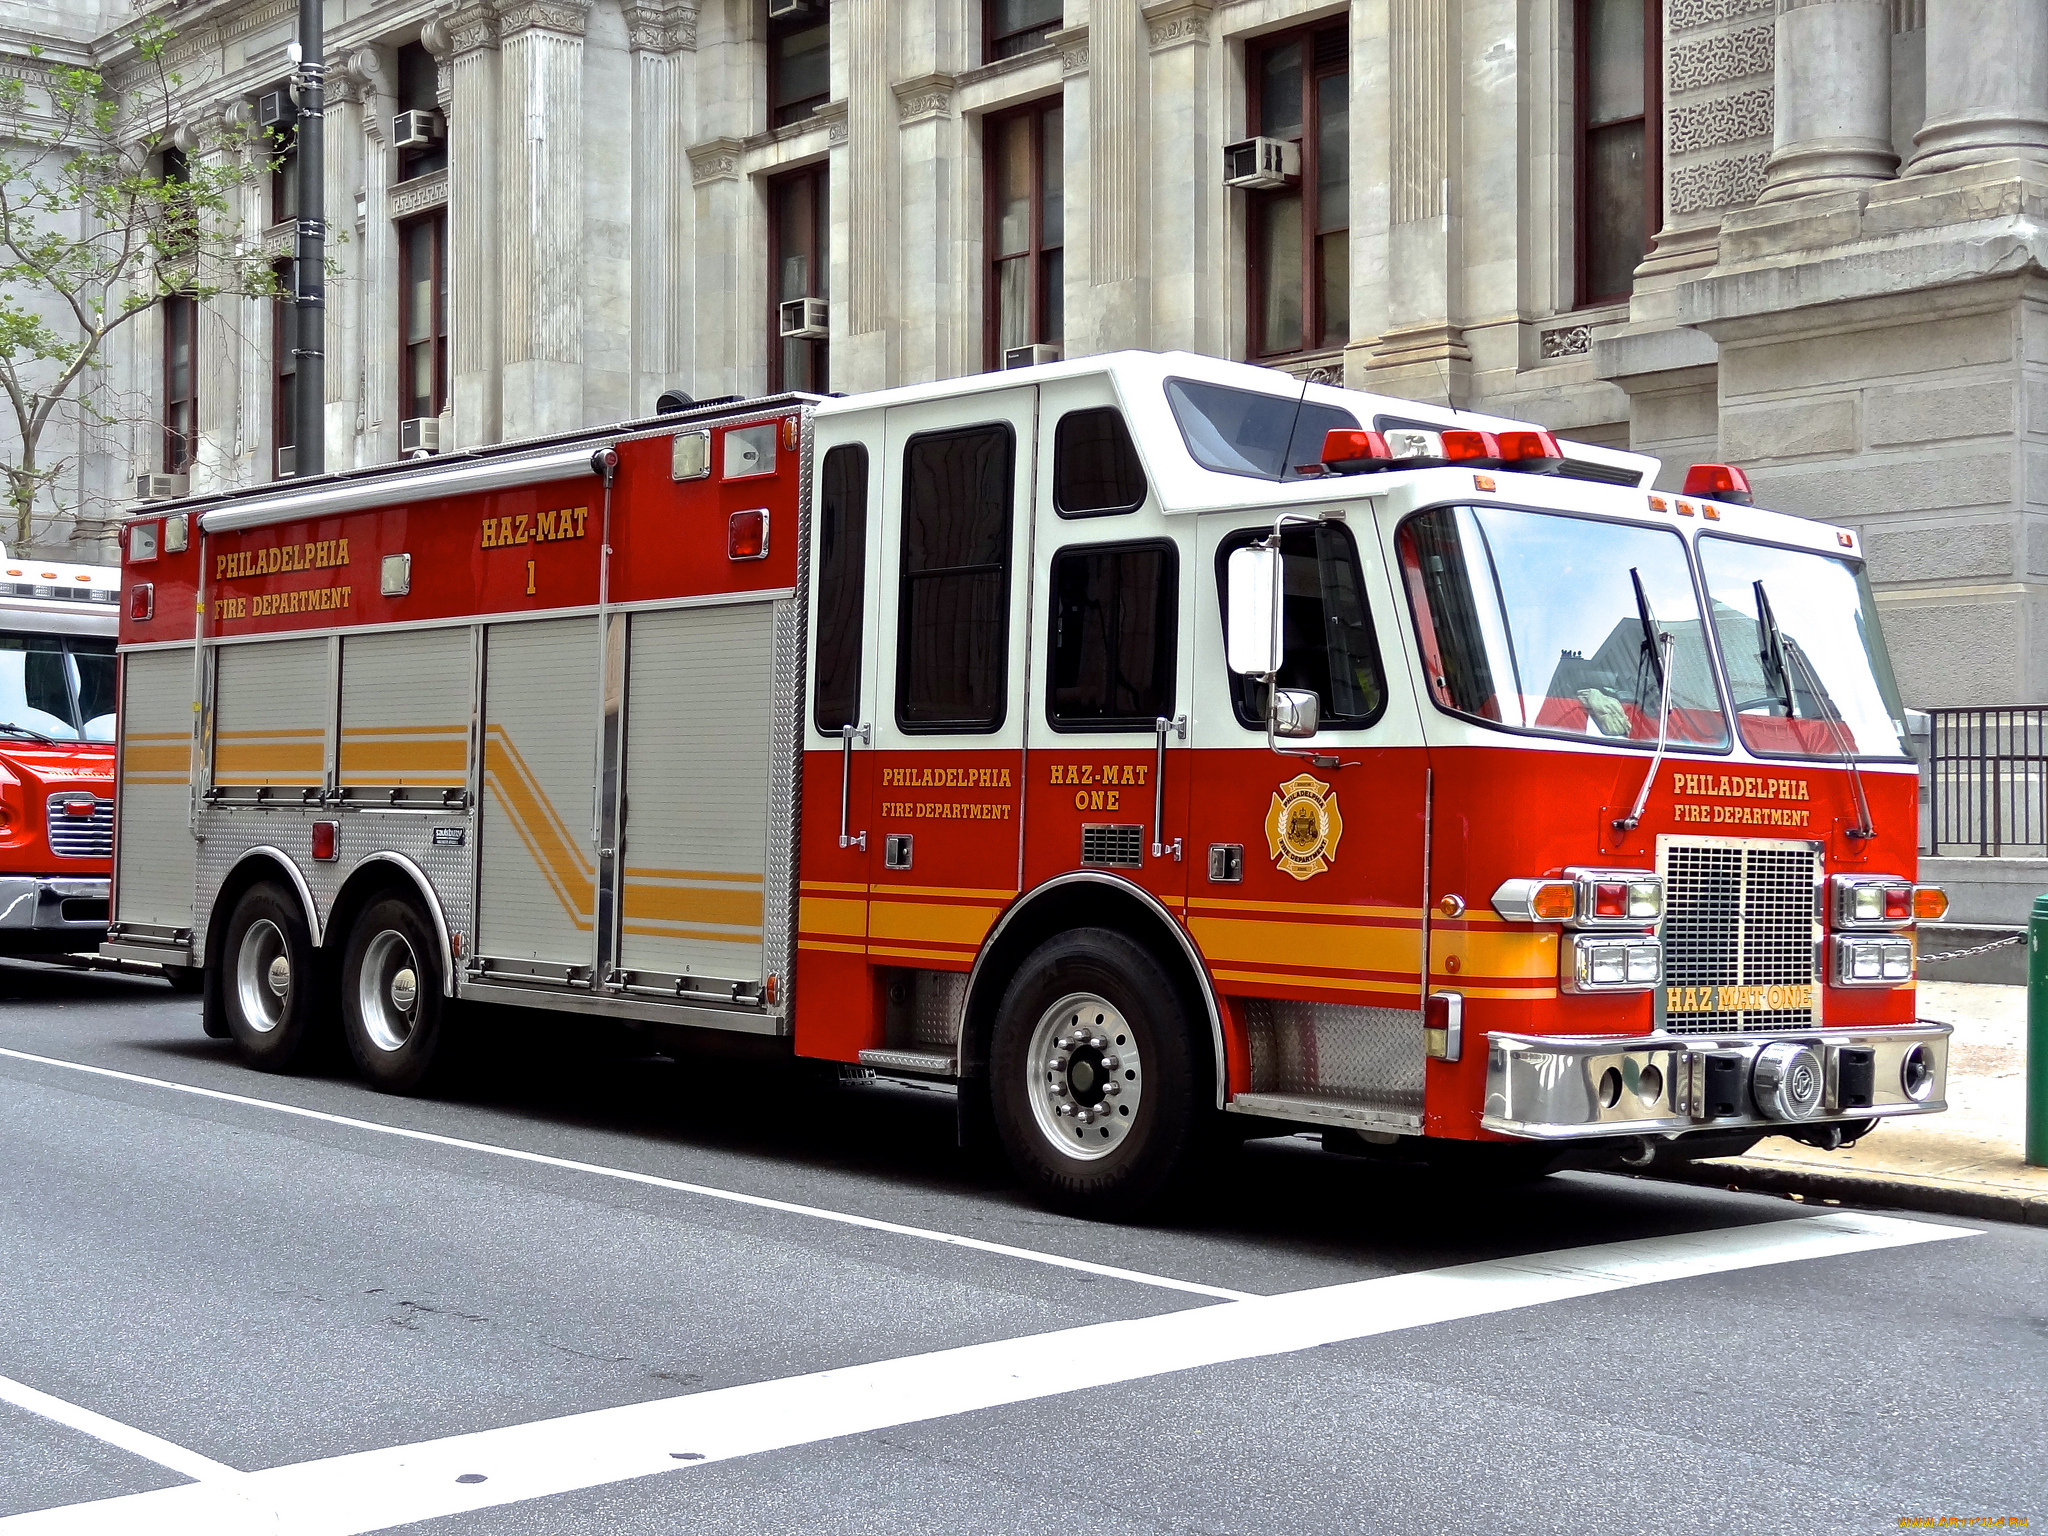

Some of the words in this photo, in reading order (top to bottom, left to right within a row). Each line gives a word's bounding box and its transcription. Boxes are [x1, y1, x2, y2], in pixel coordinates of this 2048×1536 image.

[481, 506, 588, 548] HAZ-MAT
[216, 538, 350, 580] PHILADELPHIA
[526, 560, 536, 595] 1
[214, 597, 246, 620] FIRE
[252, 586, 351, 617] DEPARTMENT
[882, 768, 1012, 787] PHILADELPHIA
[1050, 765, 1148, 785] HAZ-MAT
[1673, 773, 1810, 800] PHILADELPHIA
[882, 802, 913, 817] FIRE
[916, 803, 1011, 819] DEPARTMENT
[1075, 790, 1119, 810] ONE
[1283, 790, 1325, 808] PHILADELPHIA
[1674, 804, 1711, 822] FIRE
[1713, 805, 1810, 827] DEPARTMENT
[1279, 839, 1289, 856] FIRE
[1290, 840, 1327, 863] DEPARTMENT
[1666, 986, 1713, 1012] HAZ
[1717, 985, 1763, 1011] MAT
[1767, 984, 1813, 1010] ONE
